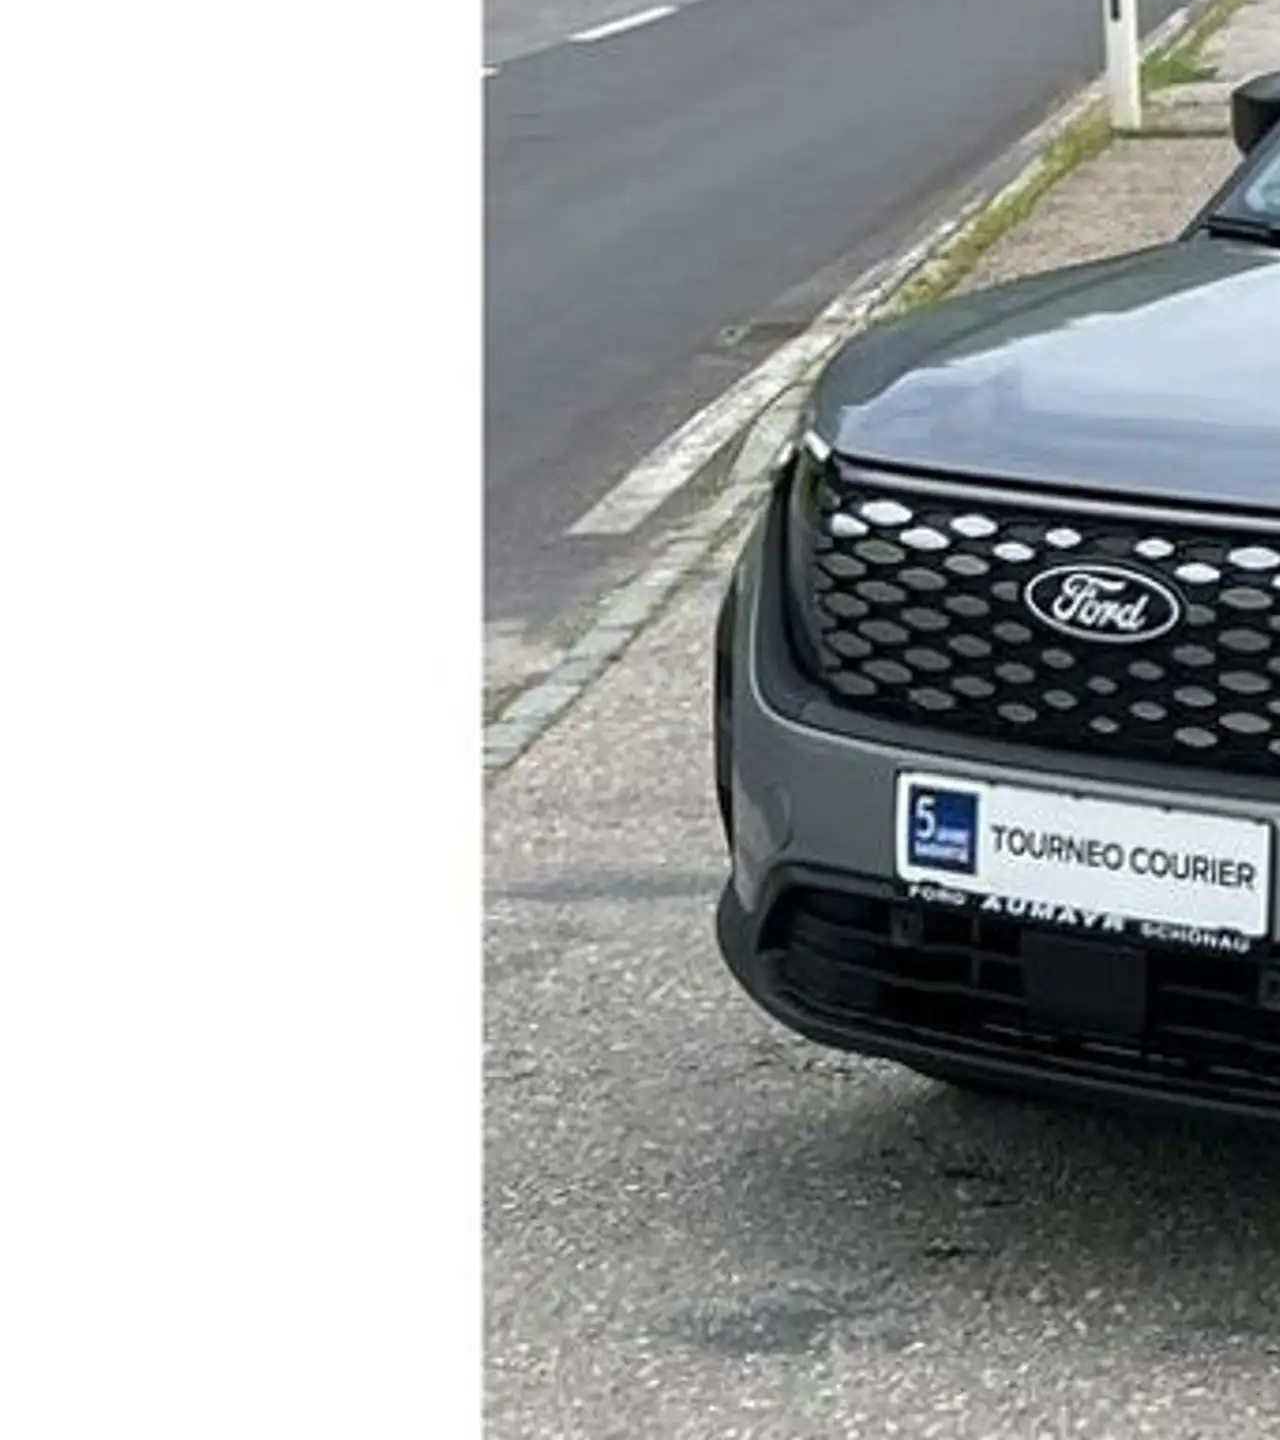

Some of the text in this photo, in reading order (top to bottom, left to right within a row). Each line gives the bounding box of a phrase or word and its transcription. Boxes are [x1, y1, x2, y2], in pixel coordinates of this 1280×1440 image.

[1053, 573, 1150, 631] Ford
[915, 795, 936, 839] 5
[990, 824, 1125, 872] TOURNEO
[1129, 846, 1258, 890] COURIER
[980, 894, 1126, 933] AUMAYR
